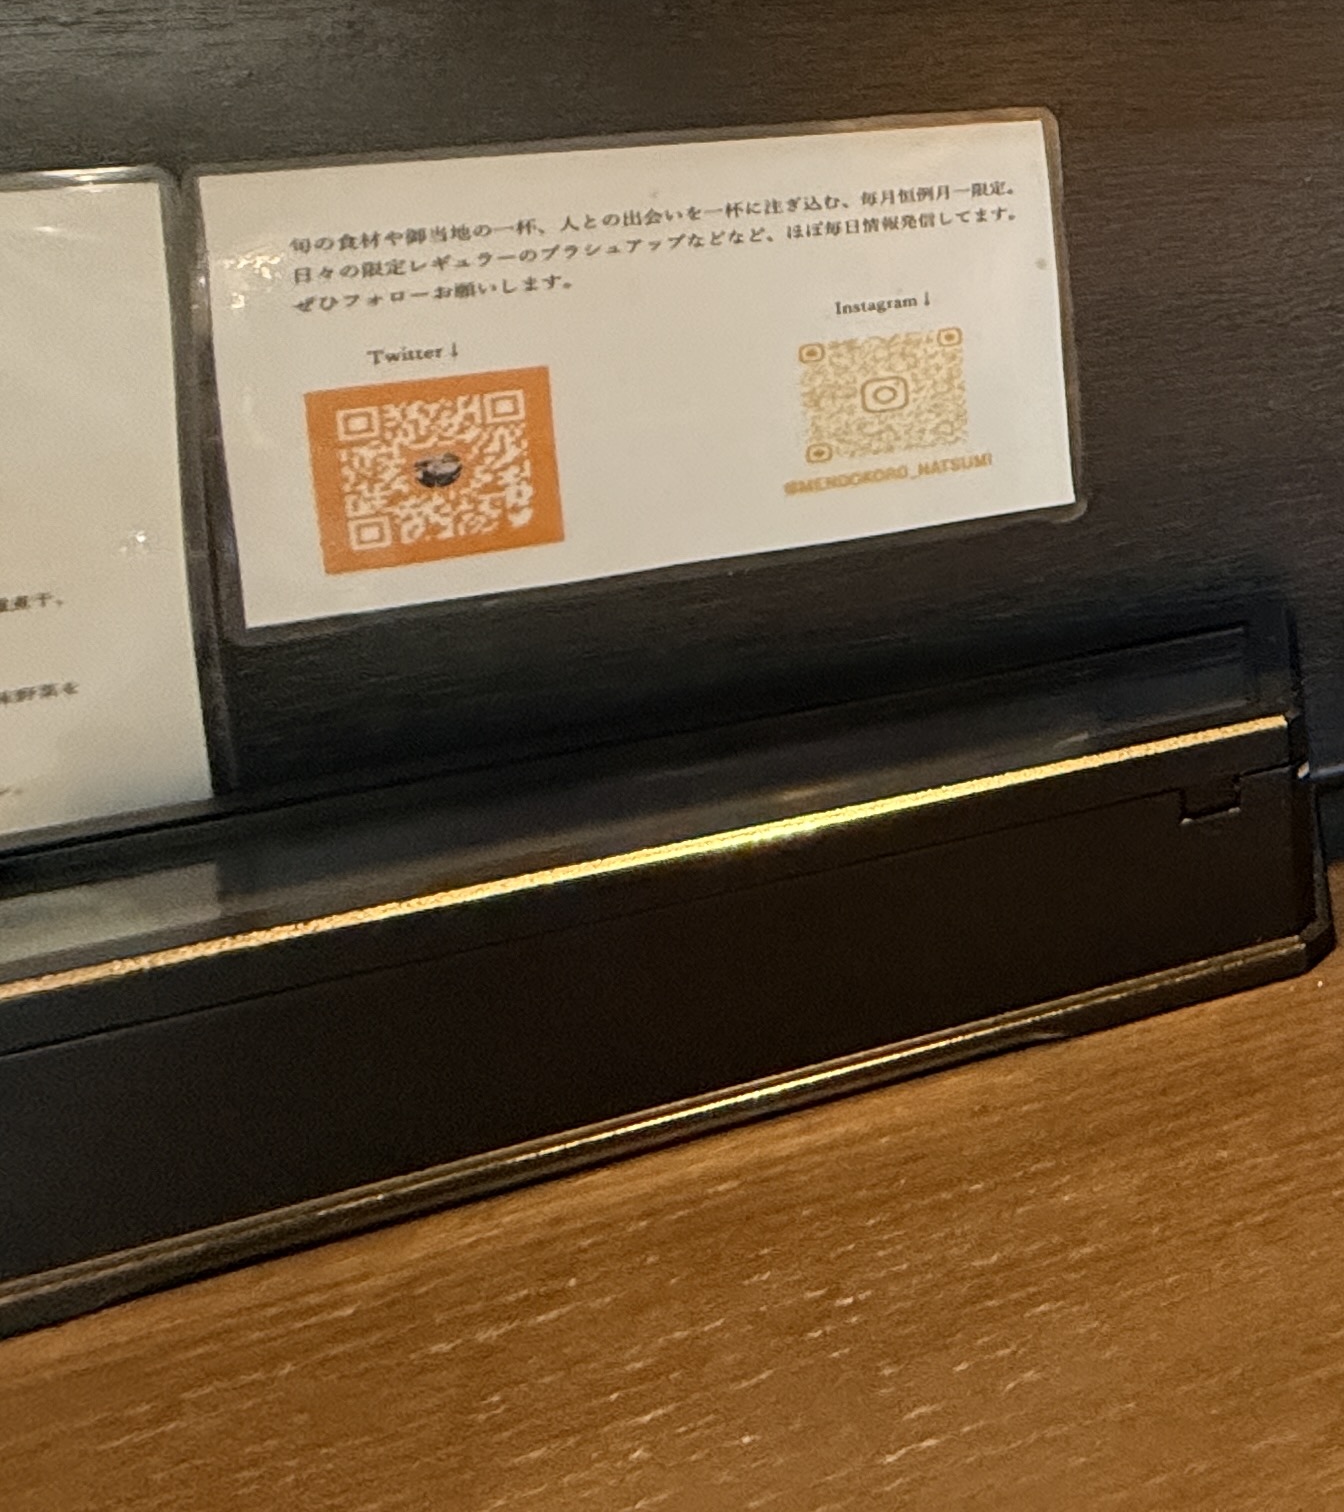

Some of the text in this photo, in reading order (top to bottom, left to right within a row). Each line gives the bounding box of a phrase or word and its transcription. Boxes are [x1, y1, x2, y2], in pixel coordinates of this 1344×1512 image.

[293, 273, 574, 314] ぜひフォローお願いします。
[834, 295, 918, 316] Instagram
[366, 344, 443, 366] Twitter
